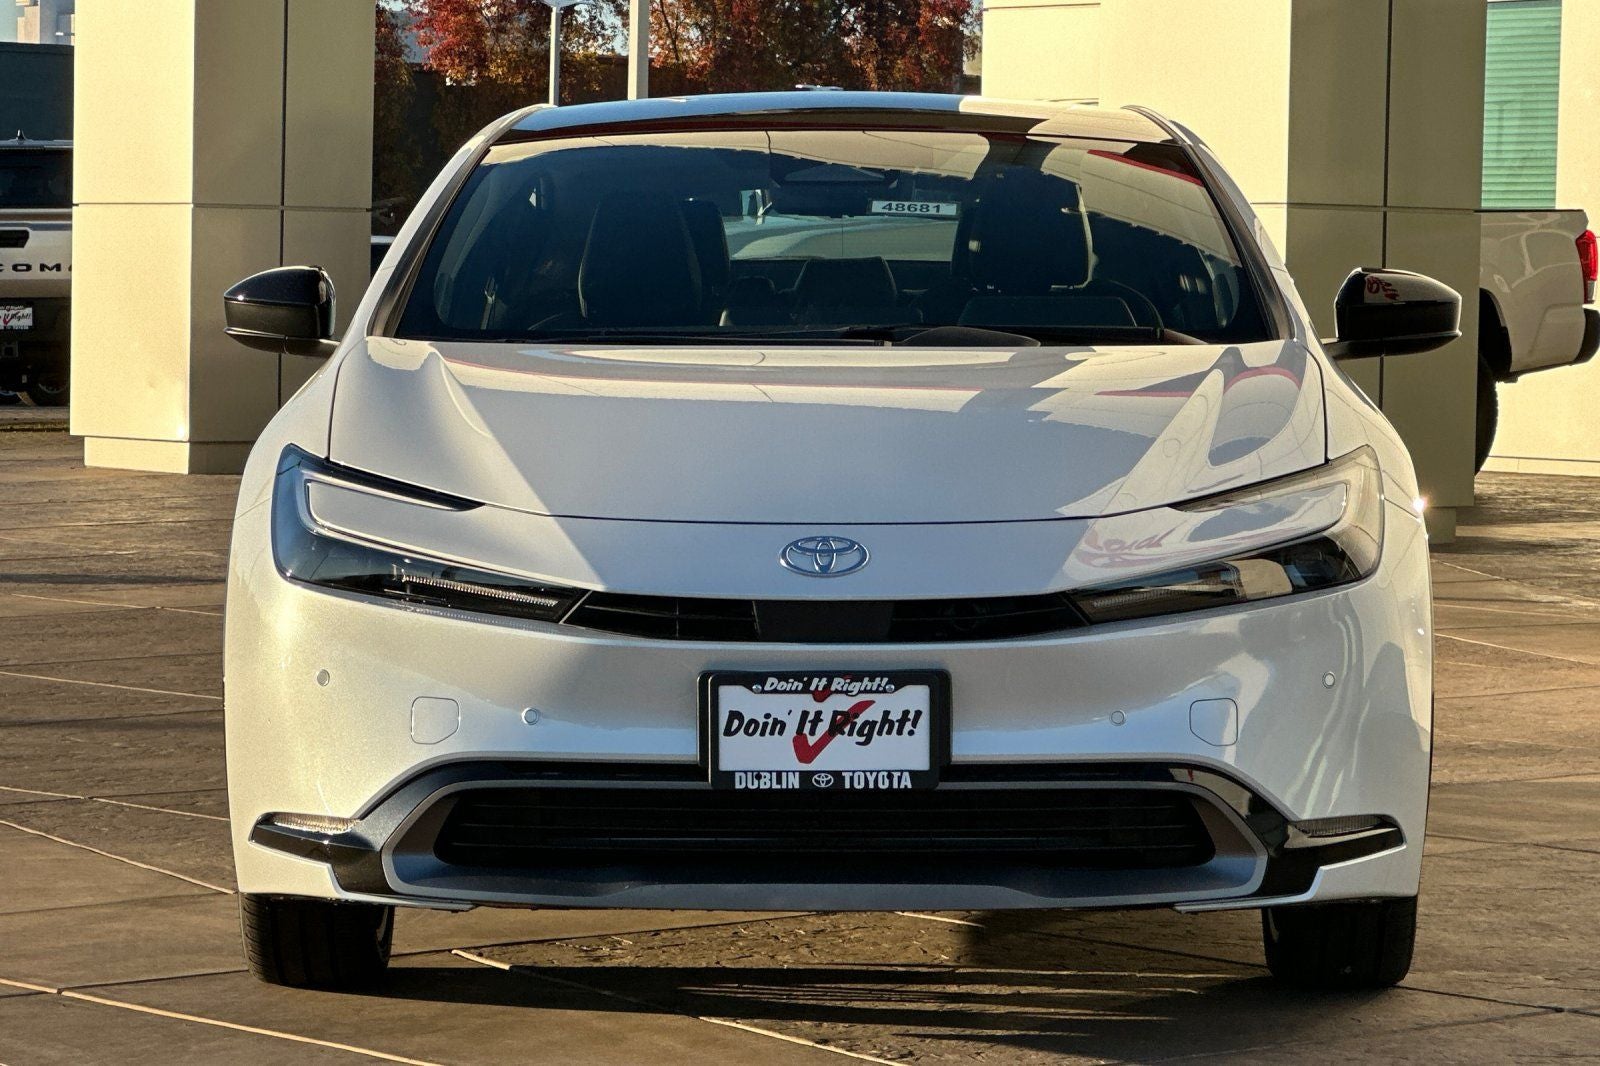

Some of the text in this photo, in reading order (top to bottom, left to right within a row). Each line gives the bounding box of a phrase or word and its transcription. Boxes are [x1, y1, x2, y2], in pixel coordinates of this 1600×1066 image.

[882, 202, 940, 213] 48681
[763, 677, 889, 696] Doin' It Right!
[722, 709, 923, 746] Doin' It Right!
[734, 772, 912, 789] DUBLIN TOYOTA
